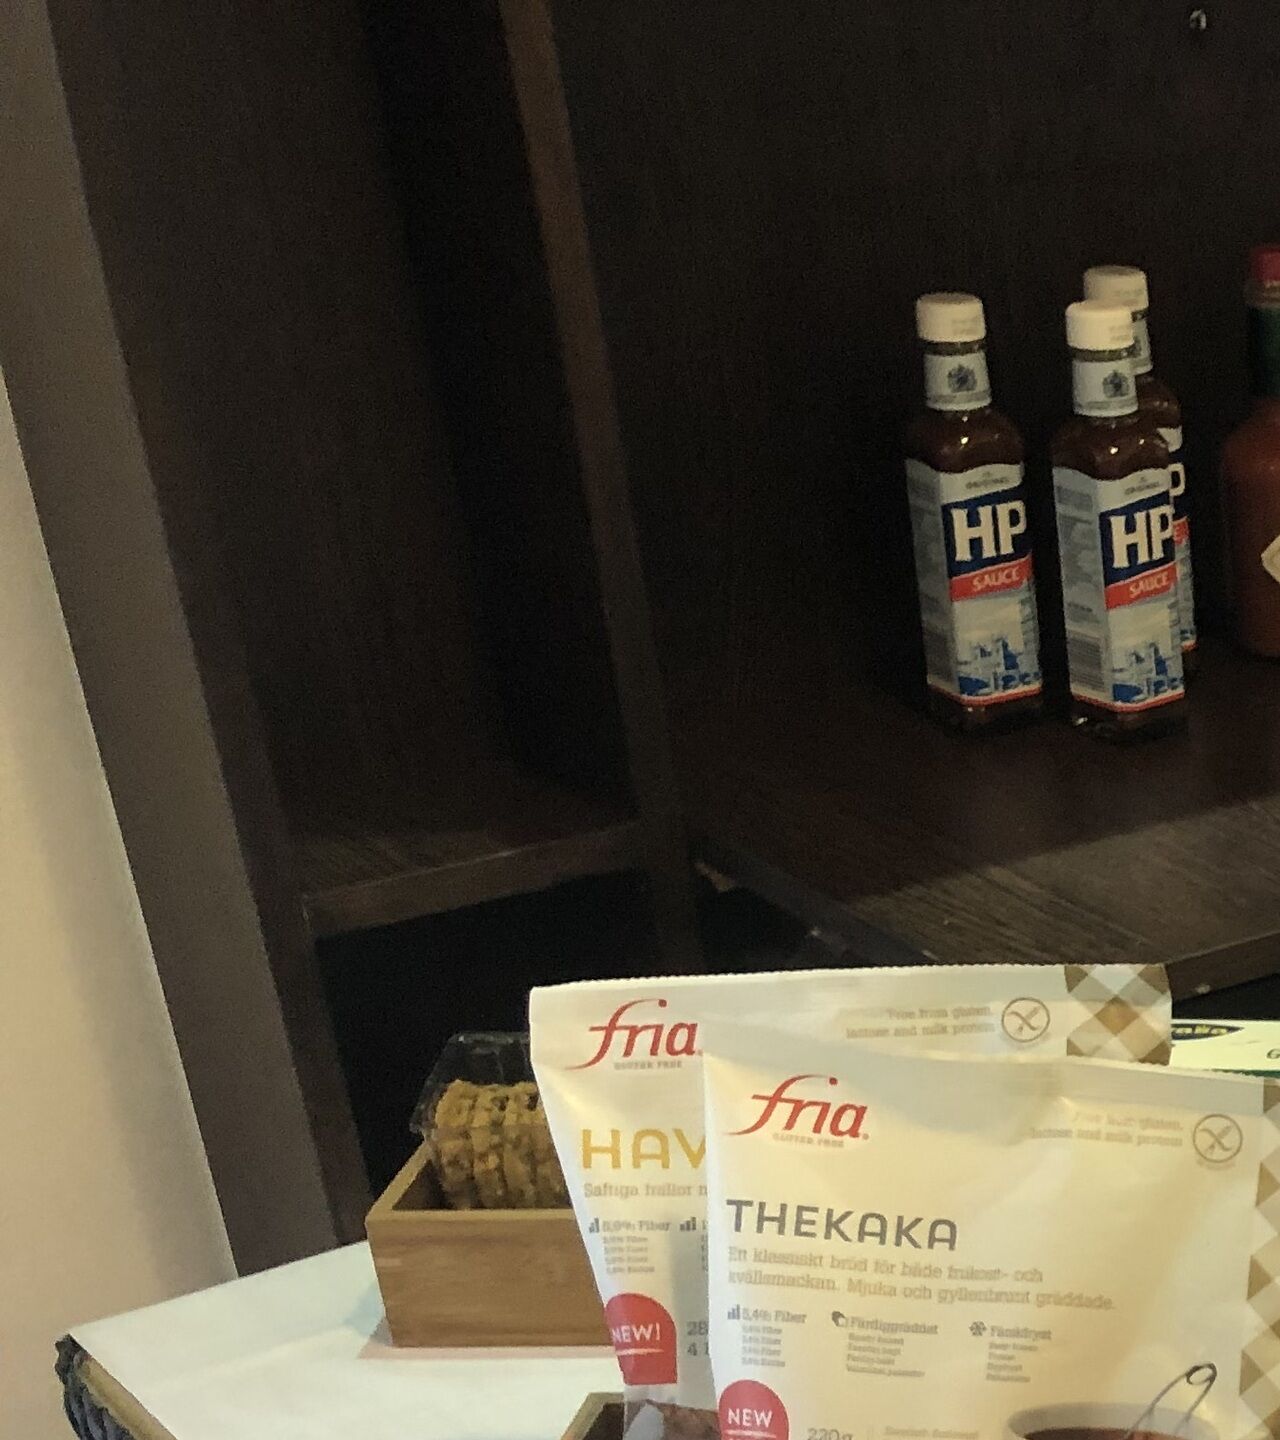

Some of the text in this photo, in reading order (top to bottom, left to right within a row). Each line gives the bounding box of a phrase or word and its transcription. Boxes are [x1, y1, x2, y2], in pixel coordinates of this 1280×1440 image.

[951, 500, 1027, 562] HP
[1110, 504, 1174, 569] HP
[971, 566, 1021, 592] SAUCE
[1129, 571, 1169, 598] SAUCE
[562, 998, 699, 1071] fria
[722, 1074, 868, 1138] fria
[726, 1199, 957, 1251] THEKAKA
[611, 1323, 662, 1344] NEW!
[727, 1408, 773, 1428] NEW
